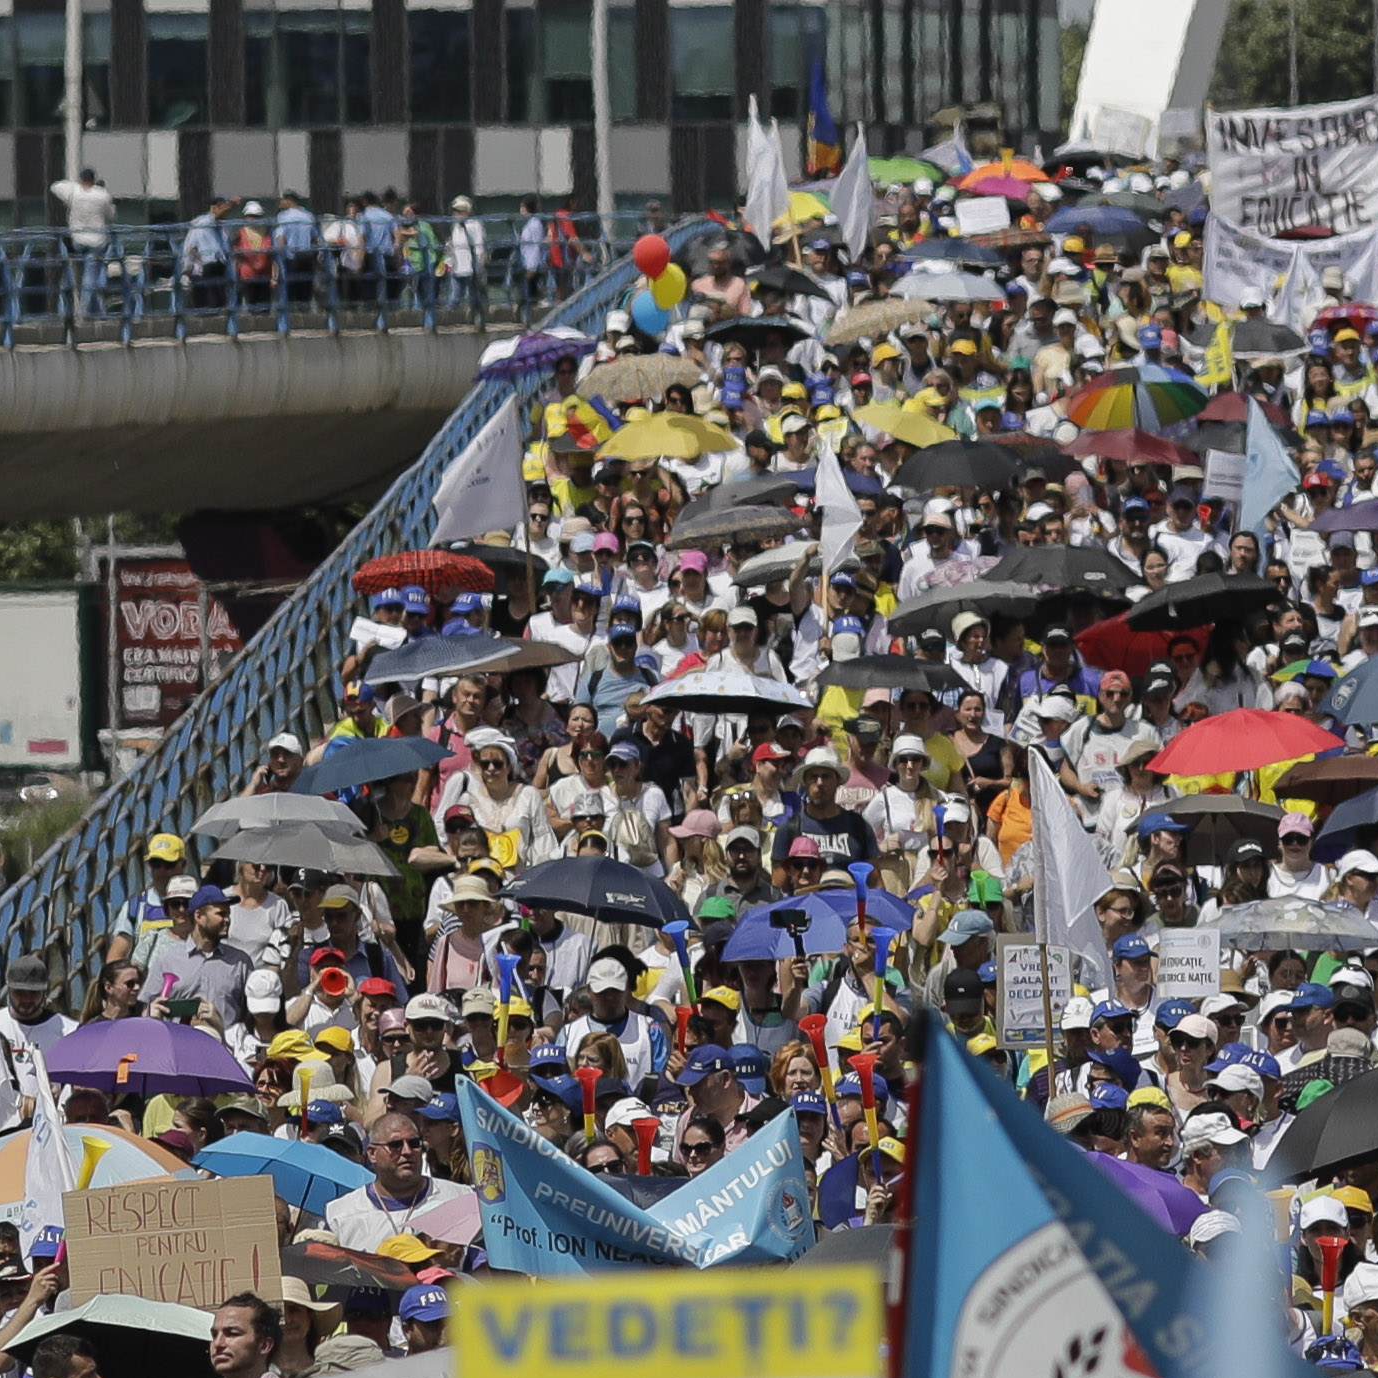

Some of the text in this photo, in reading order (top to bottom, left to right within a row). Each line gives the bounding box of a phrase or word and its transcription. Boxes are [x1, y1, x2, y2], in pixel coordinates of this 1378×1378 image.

[86, 1186, 200, 1235] RESPECT
[34, 1228, 60, 1244] SLI
[136, 1232, 207, 1257] PENTRU
